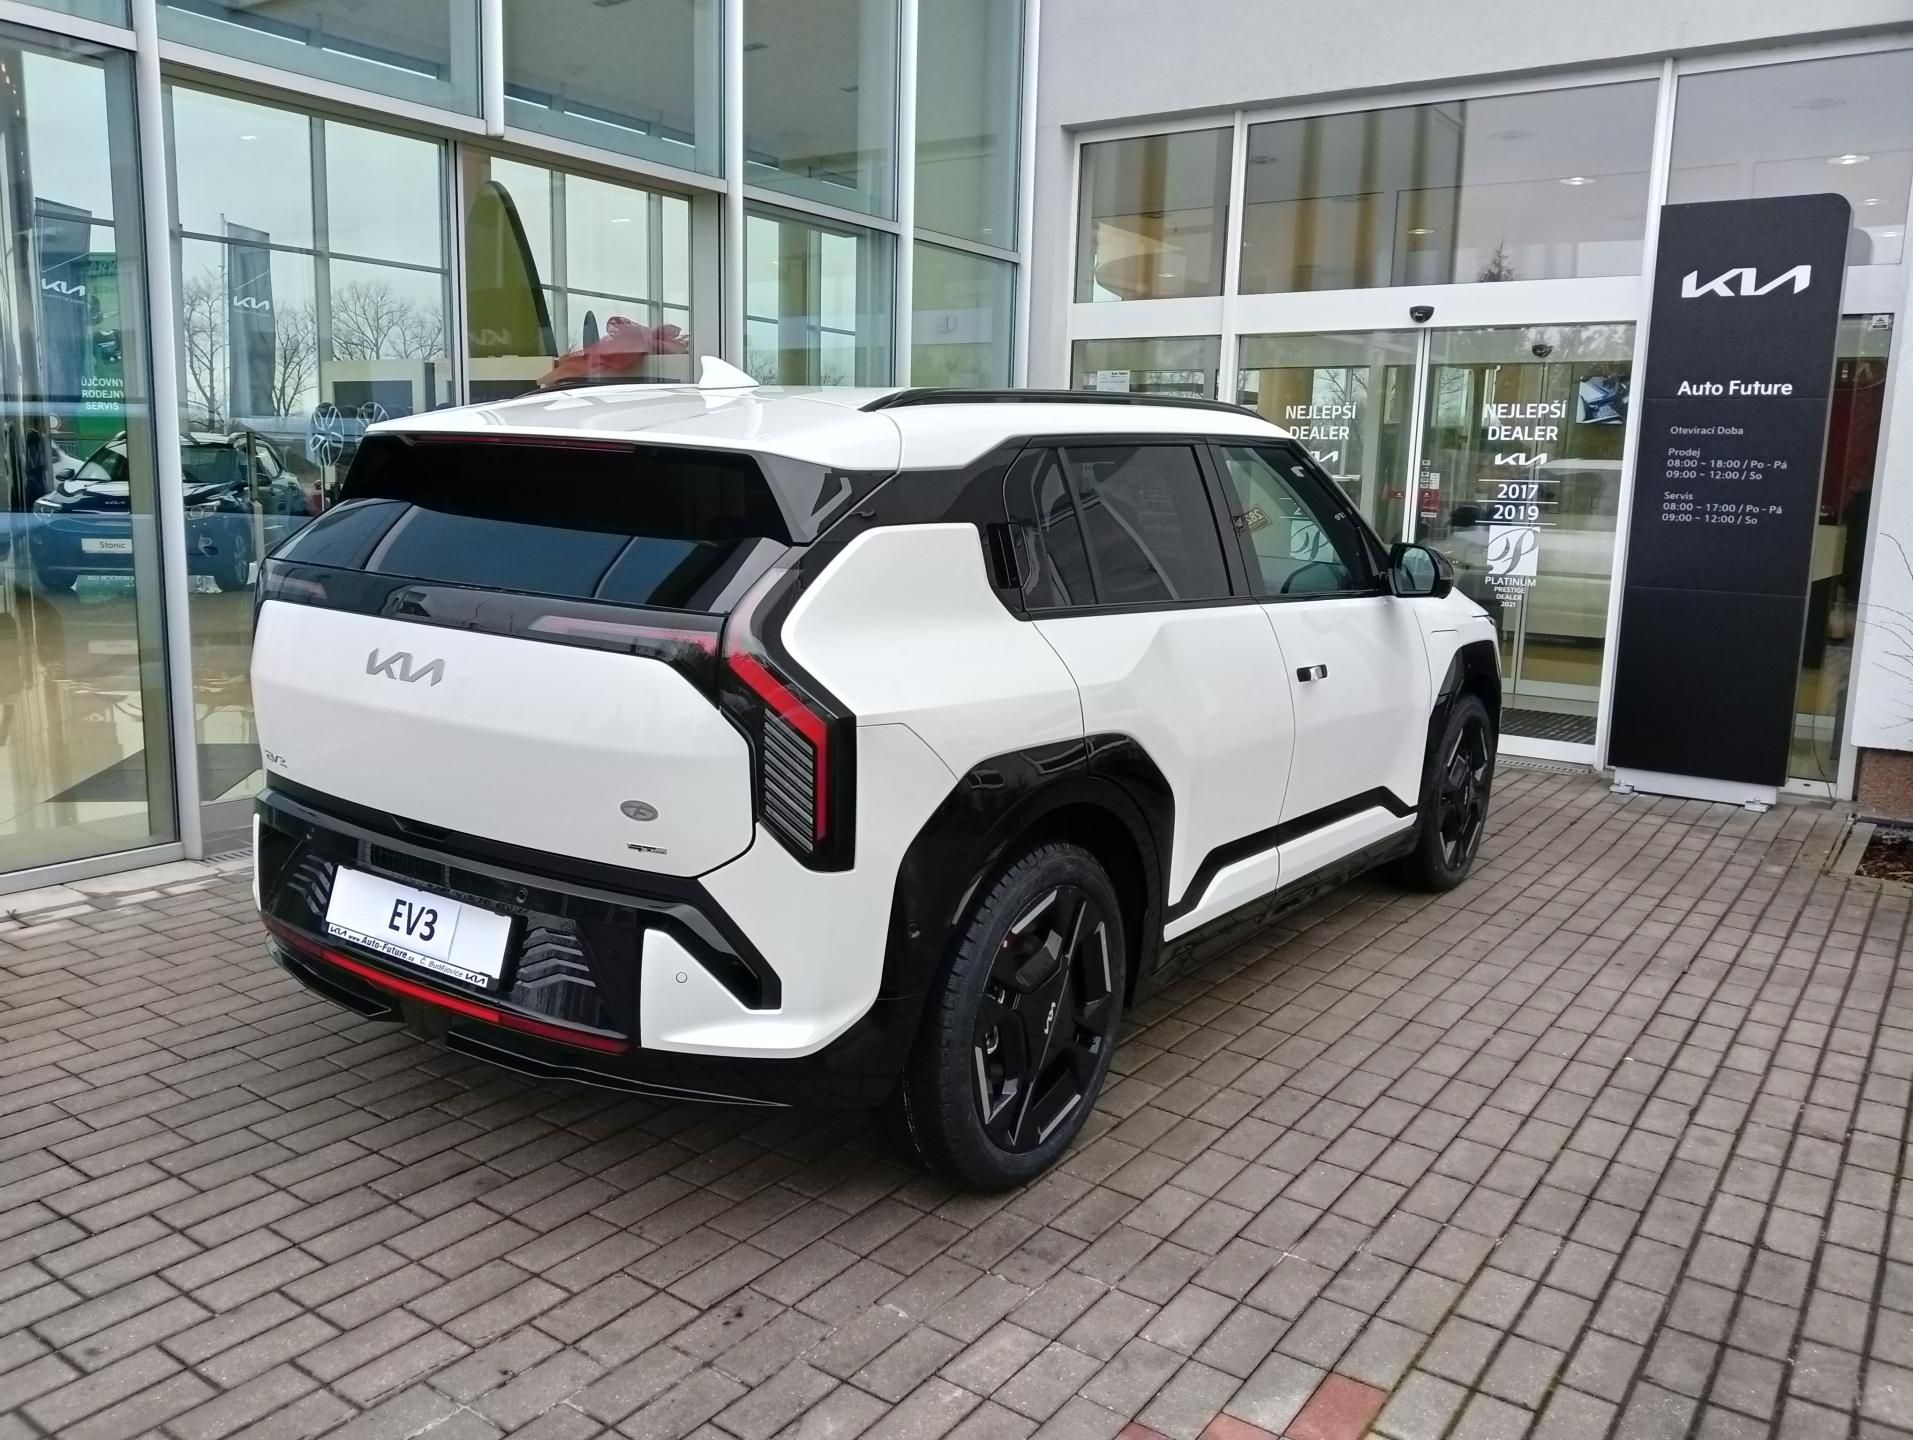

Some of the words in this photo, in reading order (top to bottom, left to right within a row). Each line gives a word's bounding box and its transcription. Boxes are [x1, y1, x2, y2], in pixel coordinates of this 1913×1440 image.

[42, 278, 85, 296] KIA
[1681, 265, 1811, 298] KIA
[233, 296, 270, 311] KIA
[82, 389, 124, 399] RODEJNY
[1677, 380, 1723, 396] Auto
[1729, 380, 1793, 396] Future
[86, 401, 120, 410] SERVIS
[1285, 402, 1357, 419] NEJLEPŠÍ
[1483, 400, 1567, 418] NEJLEPŠÍ
[1289, 426, 1350, 440] DEALER
[1488, 426, 1558, 441] DEALER
[1670, 426, 1715, 435] Otevírací
[1717, 426, 1744, 435] Doba
[1310, 451, 1339, 462] IA
[1668, 447, 1701, 458] Prodej
[1494, 453, 1548, 465] KIA
[1667, 459, 1698, 468] 08:00
[1710, 460, 1740, 469] 18:00
[1750, 460, 1764, 469] Po
[1773, 460, 1788, 469] Pá
[1666, 470, 1697, 479] 09:00
[1709, 471, 1739, 479] 12:00
[1749, 471, 1763, 480] So
[1497, 484, 1539, 499] 2017
[1664, 491, 1694, 500] Servis
[1493, 505, 1539, 520] 2019
[1662, 502, 1693, 511] 08:00
[1706, 503, 1736, 512] 17:00
[1746, 504, 1760, 513] Po
[1769, 505, 1783, 514] Pá
[1662, 513, 1692, 522] 09:00
[1705, 514, 1735, 523] 12:00
[1745, 515, 1758, 524] So
[100, 541, 126, 549] Stonic
[1484, 576, 1537, 587] PLATINUM
[1494, 586, 1526, 594] PRESTIGE
[366, 648, 445, 687] KIA
[388, 898, 438, 941] EV3
[330, 926, 347, 937] KIA
[465, 972, 486, 985] KIA
